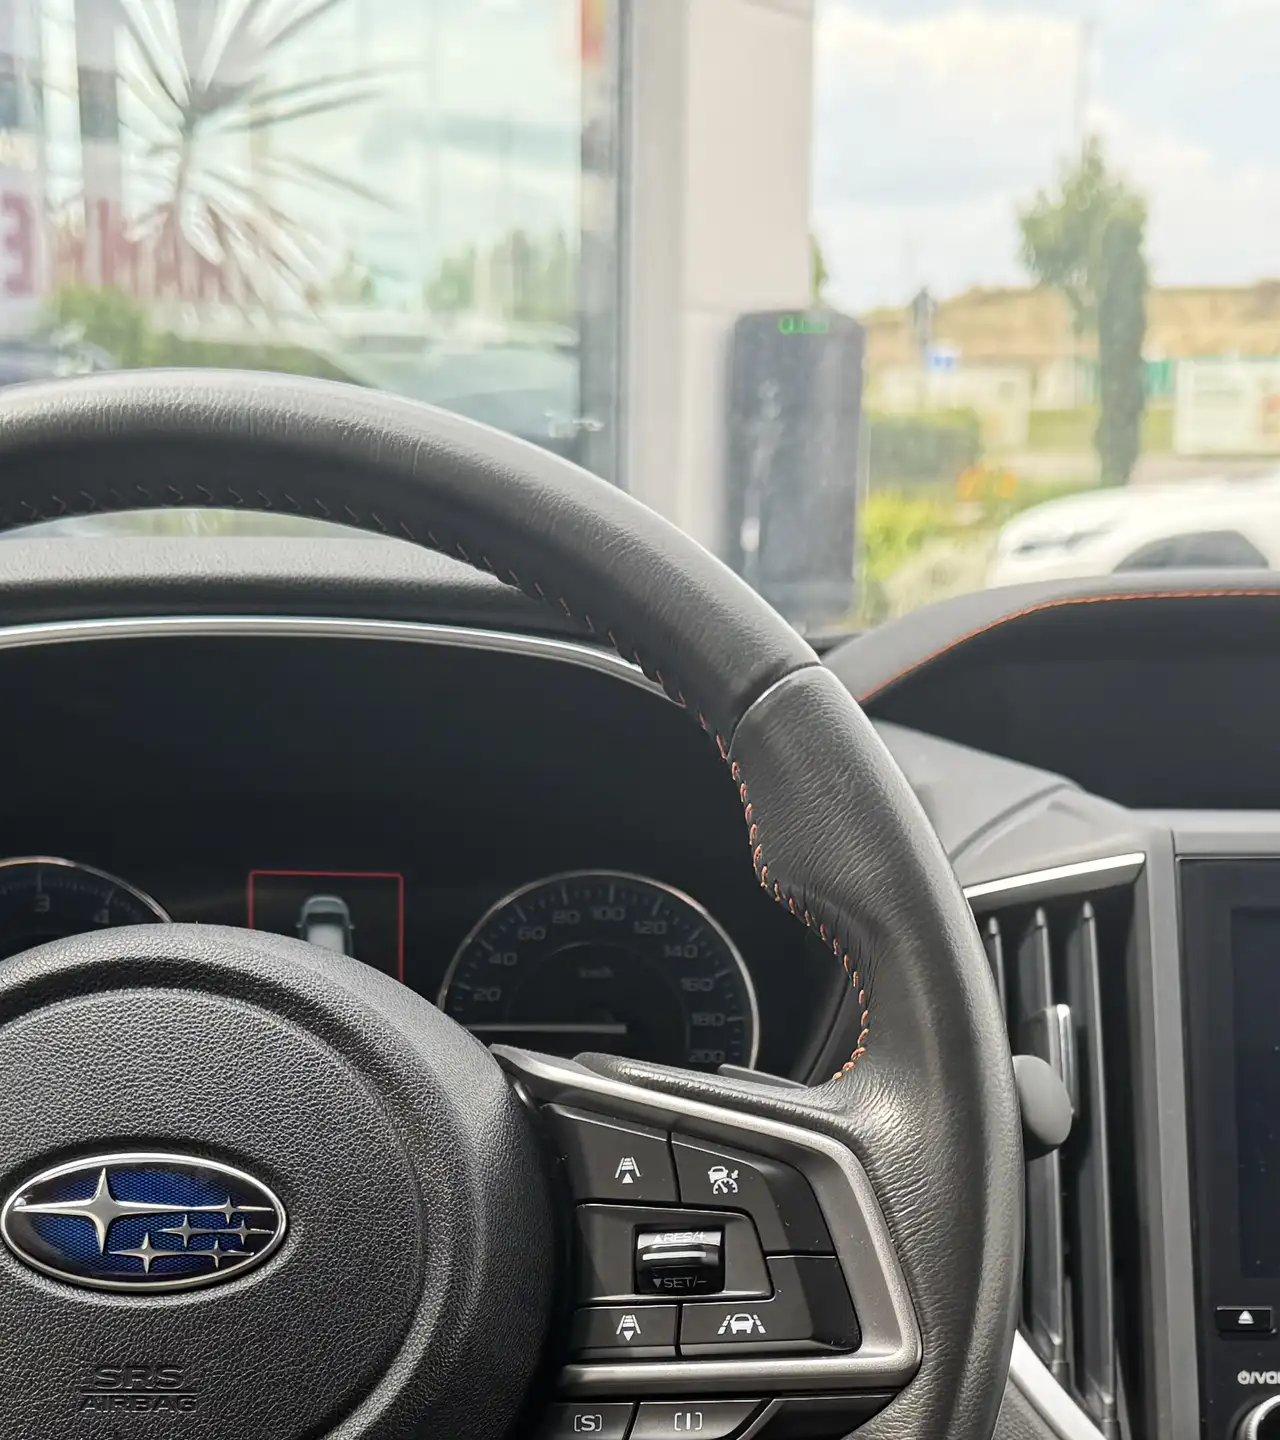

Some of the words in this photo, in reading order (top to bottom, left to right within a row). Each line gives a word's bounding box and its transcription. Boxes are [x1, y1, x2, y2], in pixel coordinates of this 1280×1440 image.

[35, 894, 50, 912] 3
[592, 906, 625, 920] 100
[518, 926, 546, 940] 60
[634, 921, 668, 935] 120
[664, 944, 698, 958] 140
[489, 952, 517, 966] 40
[680, 978, 714, 991] 160
[474, 987, 501, 1001] 20
[692, 1014, 725, 1026] 180
[689, 1051, 725, 1062] 200
[94, 1366, 184, 1389] SRS
[80, 1395, 196, 1412] AIRBAG
